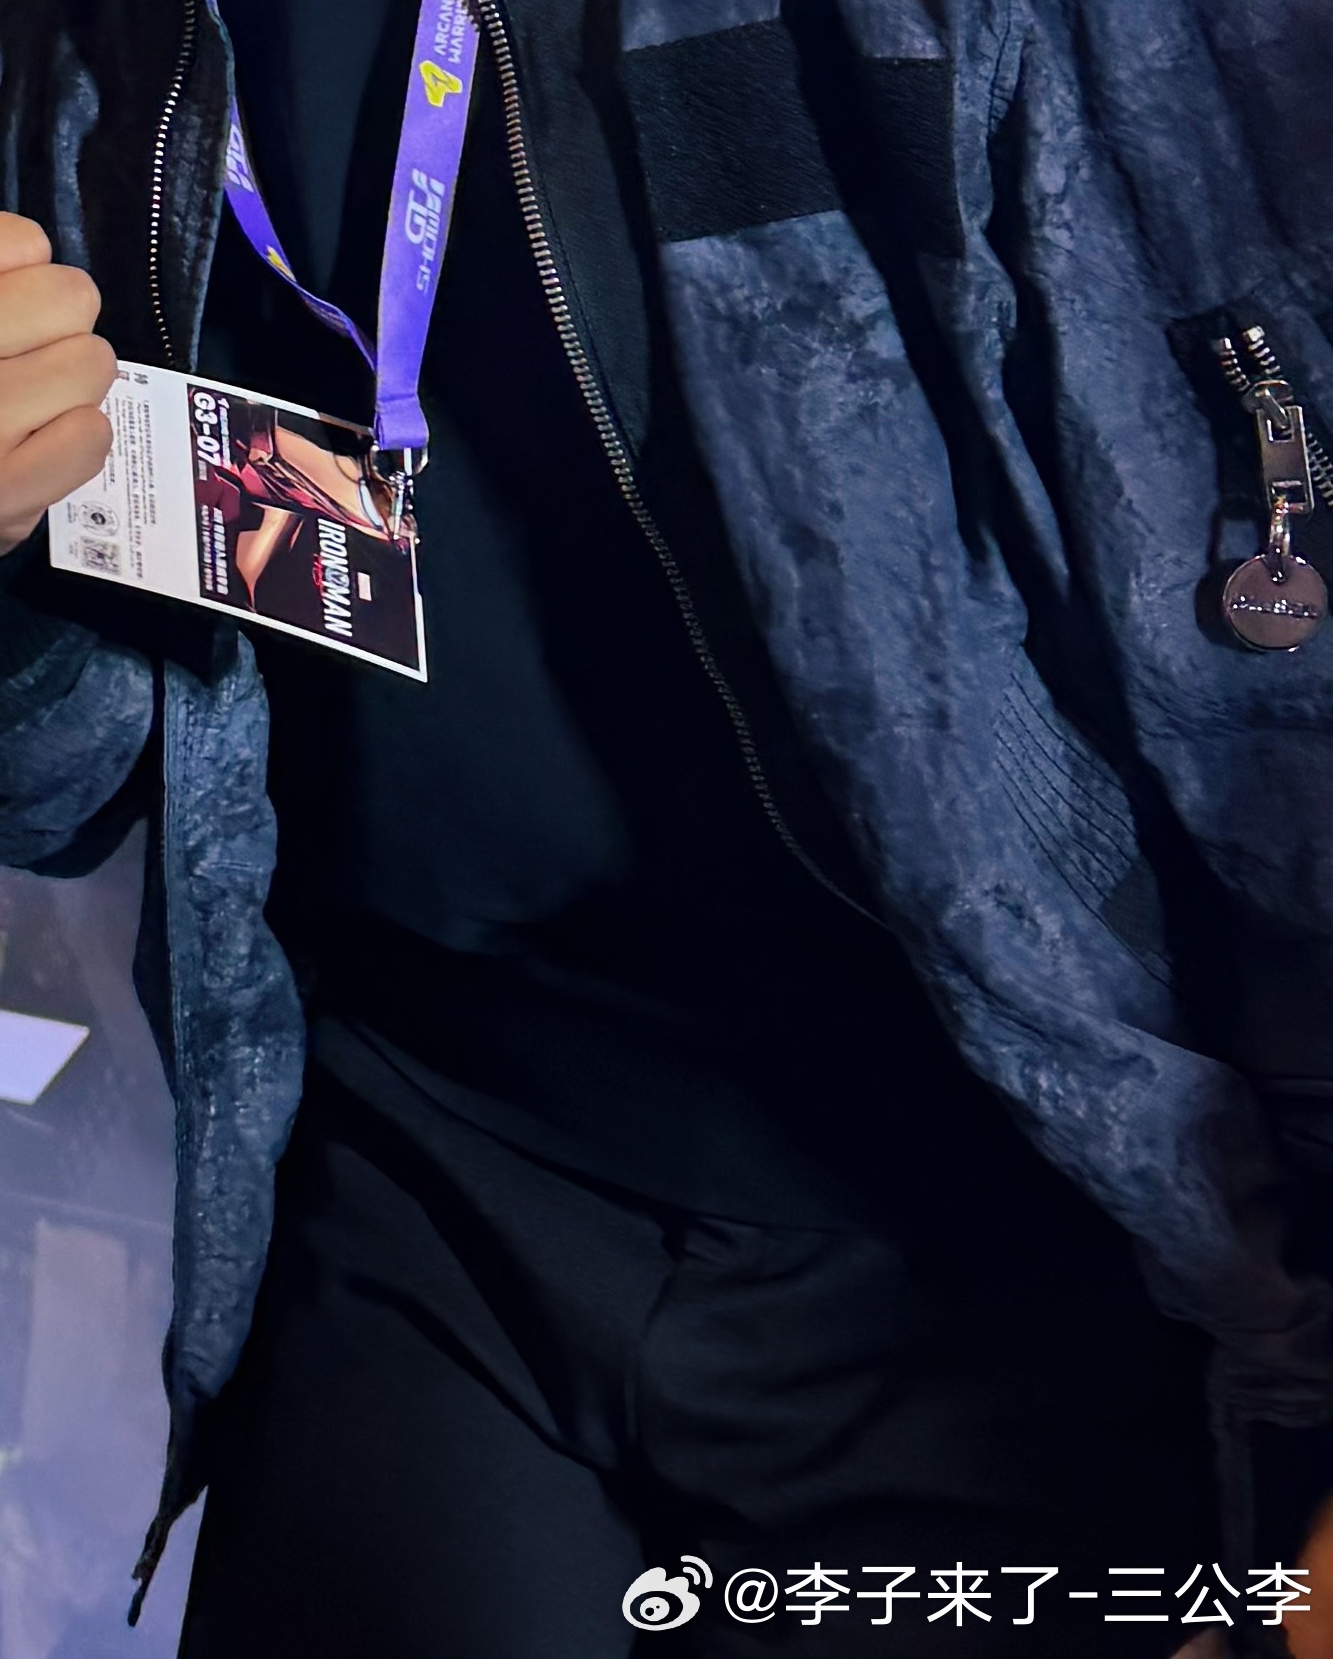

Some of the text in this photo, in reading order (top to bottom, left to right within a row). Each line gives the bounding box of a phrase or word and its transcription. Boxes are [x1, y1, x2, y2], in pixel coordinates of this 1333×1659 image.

[193, 391, 222, 467] G3-07
[318, 518, 353, 637] IRON MAN
